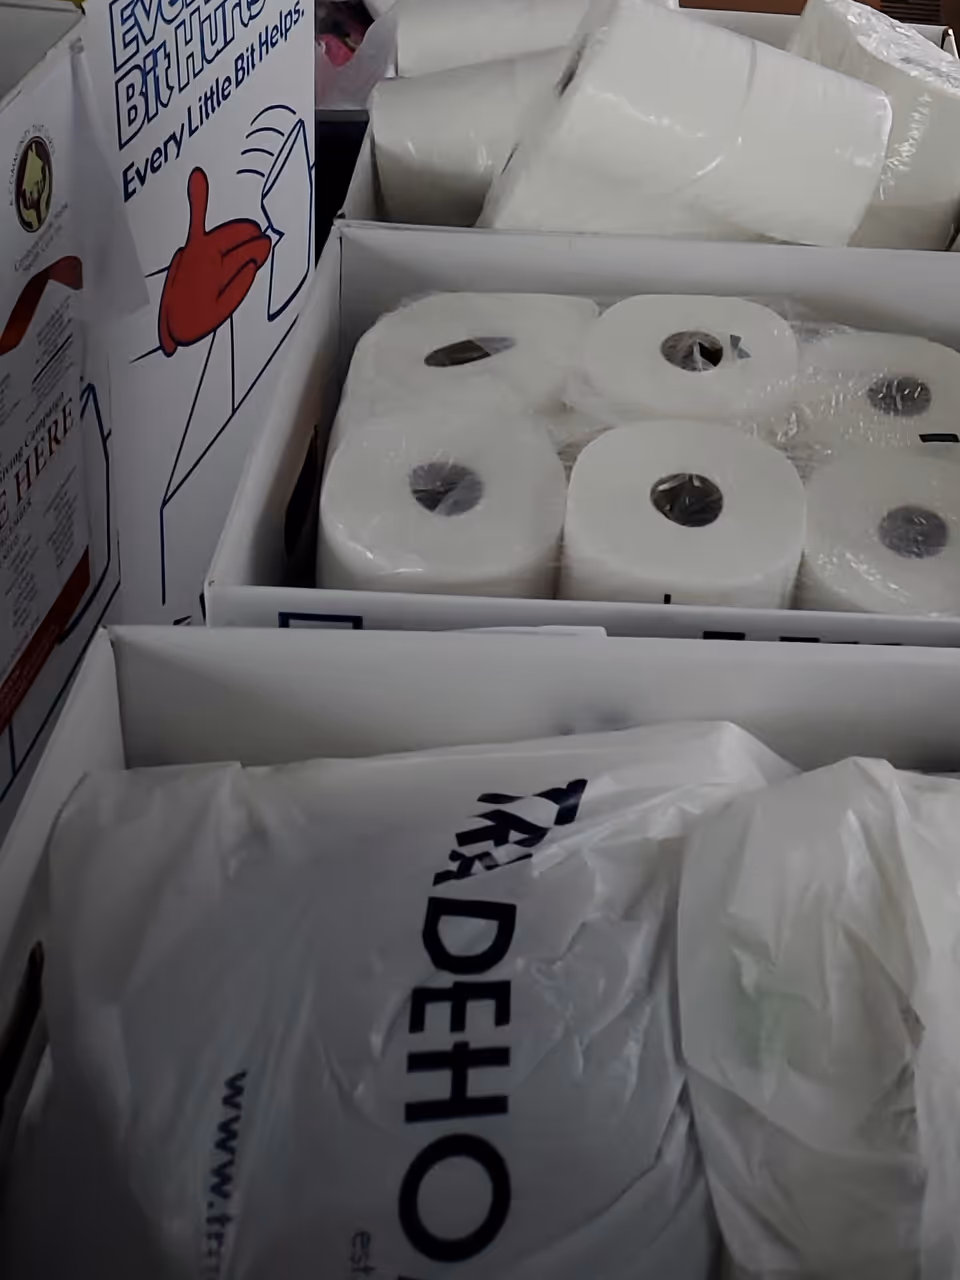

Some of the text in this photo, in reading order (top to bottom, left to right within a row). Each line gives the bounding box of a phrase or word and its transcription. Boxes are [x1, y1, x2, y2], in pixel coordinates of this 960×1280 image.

[115, 40, 175, 151] Bit
[122, 0, 305, 203] Every Little Bit Helps.
[14, 397, 74, 507] HERE
